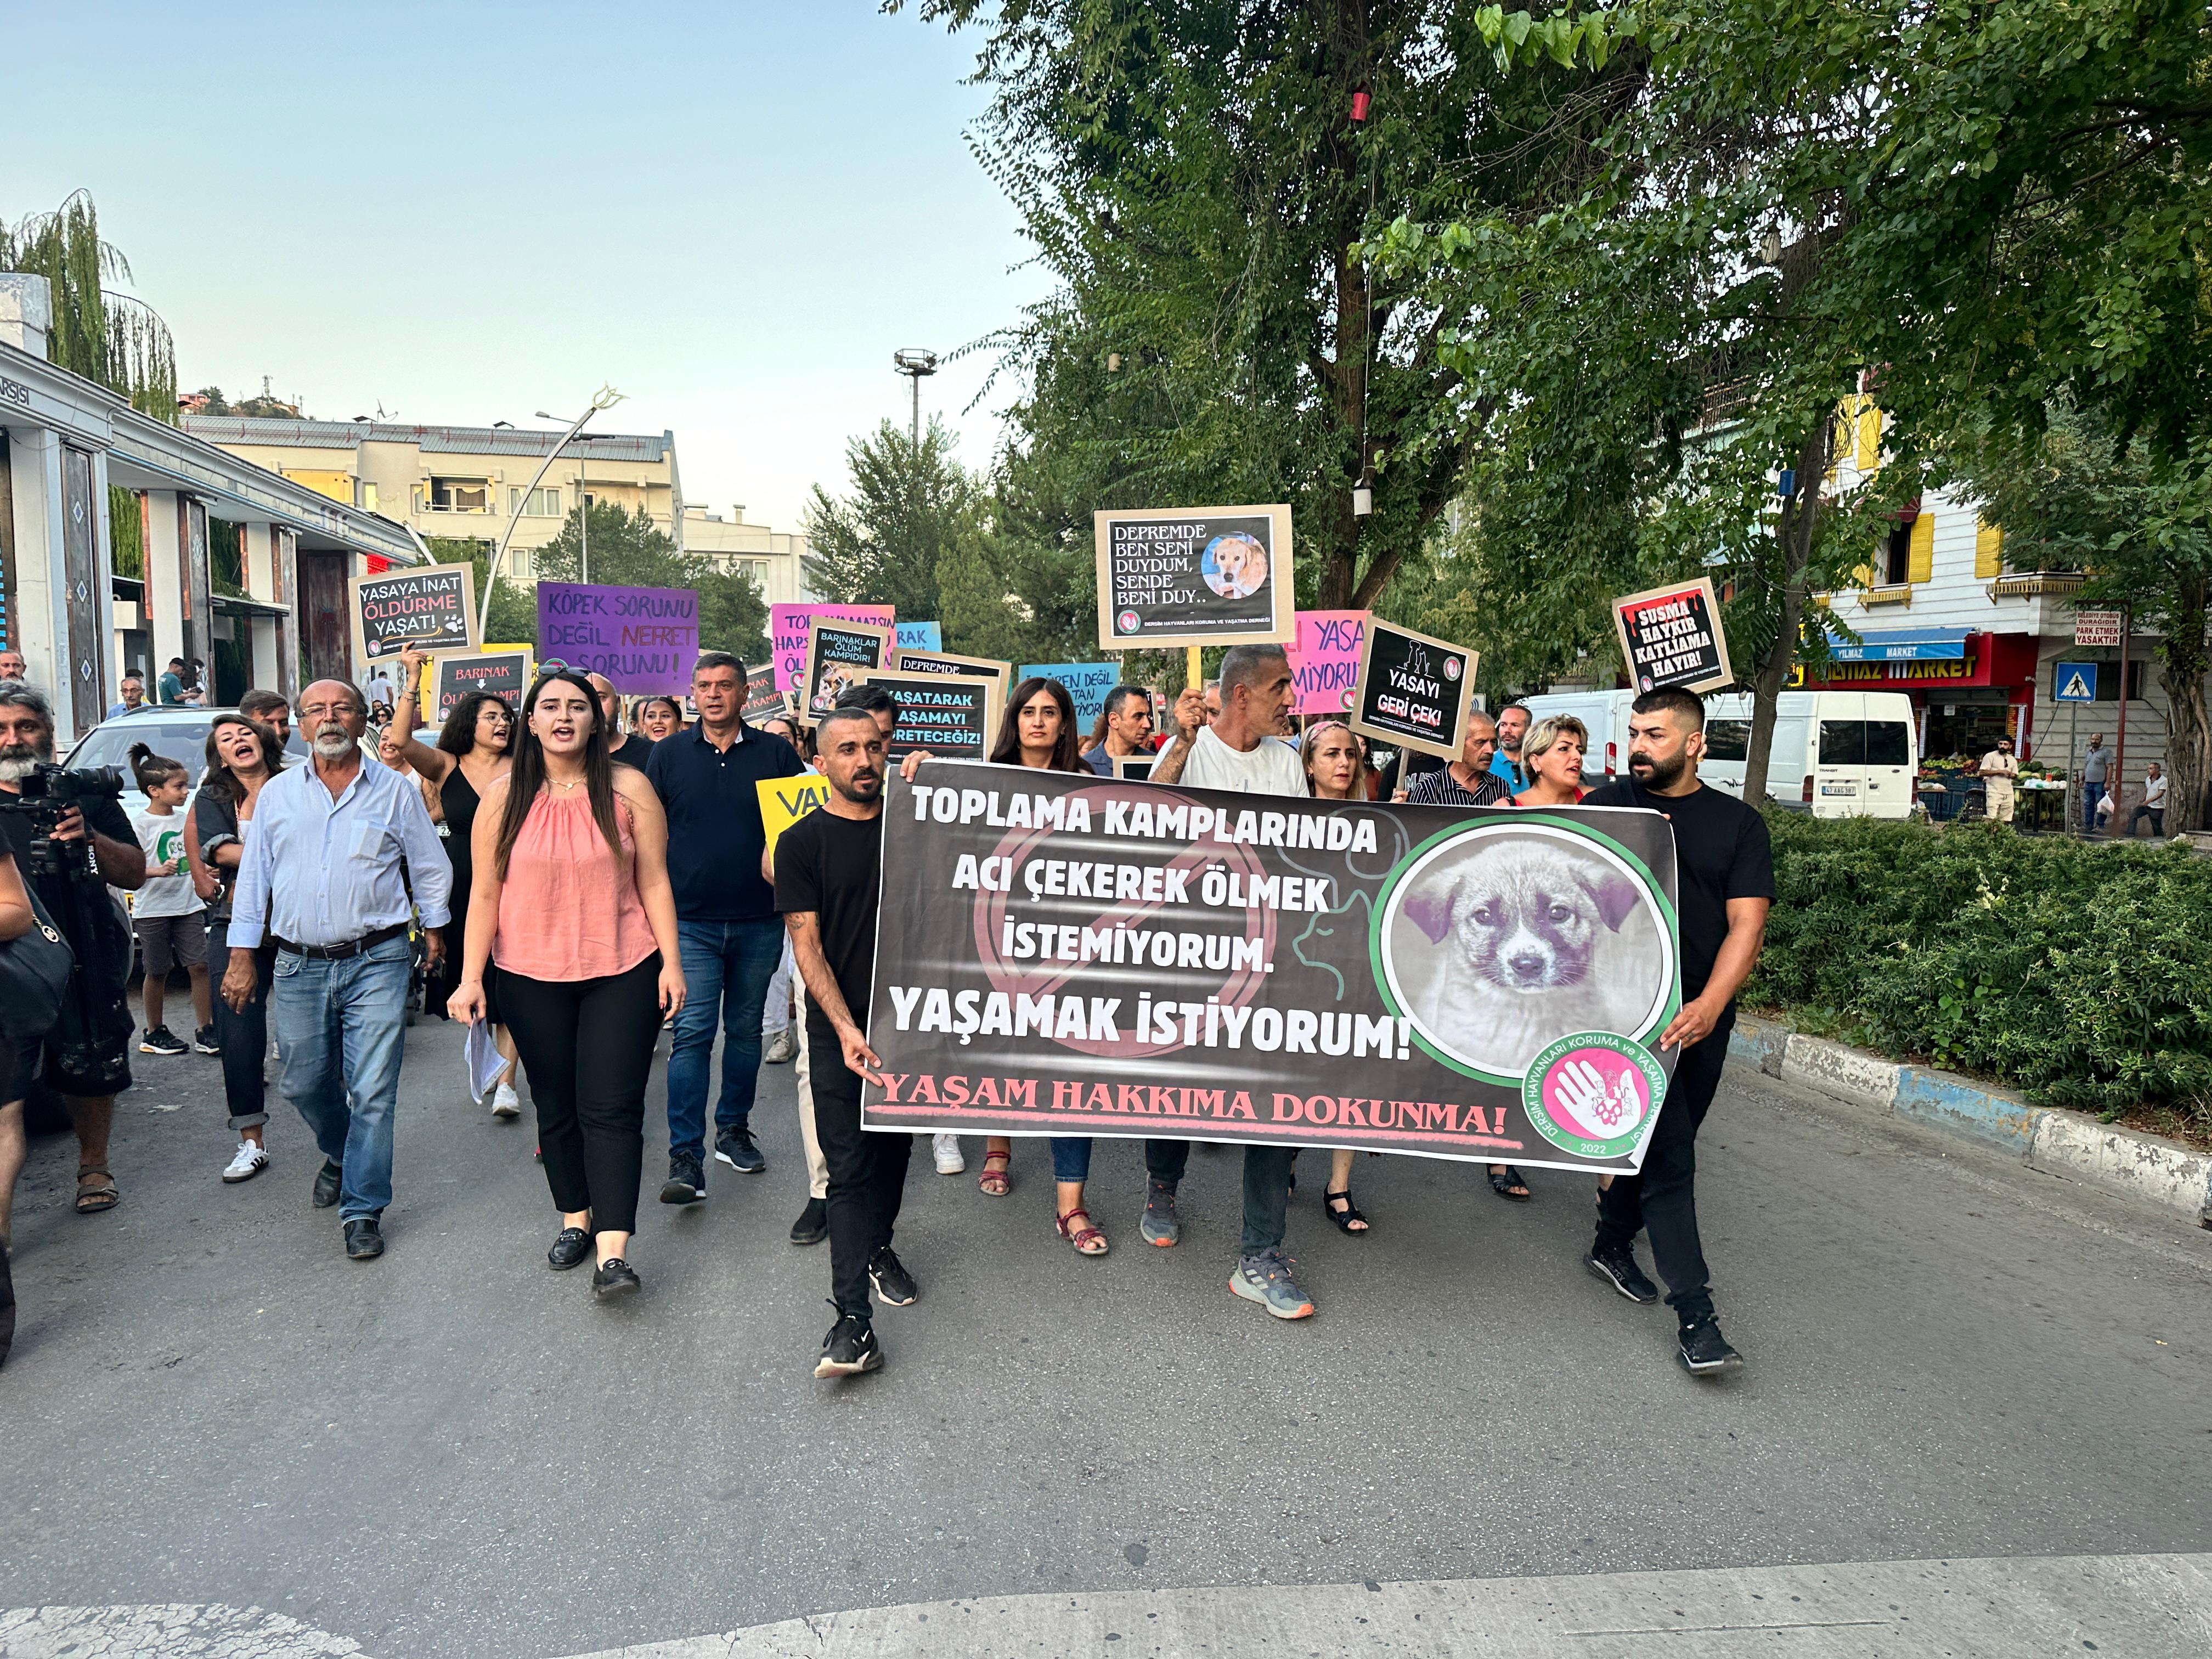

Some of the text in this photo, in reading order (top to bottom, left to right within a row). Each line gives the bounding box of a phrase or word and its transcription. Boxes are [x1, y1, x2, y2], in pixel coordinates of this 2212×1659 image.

[1114, 524, 1207, 541] DEPREMDE
[1115, 539, 1193, 557] BEN SENİ
[1116, 558, 1193, 573] DUYDUM,
[360, 577, 460, 602] YASAYA İNAT
[1116, 574, 1173, 589] SENDE
[549, 589, 693, 619] KÖPEK SORUNU
[1117, 588, 1206, 605] BENİ DUY..
[364, 594, 458, 620] ÖLDÜRME
[1638, 601, 1690, 627] SUSMA
[375, 614, 436, 636] YAŞAT!
[549, 621, 696, 646] DEĞİL NEFRET
[1640, 617, 1697, 644] HAYKIR
[821, 632, 877, 648] BARINAKLAR
[835, 641, 862, 653] ÖLÜM
[897, 630, 927, 644] RAK
[2076, 635, 2118, 644] YASAKTIR
[824, 649, 871, 663] KAMPIDIR!
[1635, 631, 1711, 664] KATLİAMA
[1838, 646, 1917, 659] YILMAZ MARKET
[456, 665, 510, 680] BARINAK
[903, 659, 960, 675] DEPREMDE
[1651, 651, 1702, 678] HAYIR!
[1827, 656, 1977, 680] ILMAZ MARKET
[1085, 669, 1113, 687] DEĞİL
[1289, 661, 1361, 693] MİYORU
[1389, 669, 1440, 699] YASAYI
[493, 690, 520, 701] MPI
[753, 692, 782, 708] KAMPI
[1071, 688, 1095, 701] TAN
[898, 710, 966, 726] AŞAMAYI
[1378, 694, 1442, 726] GERİ ÇEK!
[892, 729, 981, 744] RETECEĞİZ!
[911, 785, 1378, 854] TOPLAMA KAMPLARINDA
[88, 845, 99, 875] SONY
[952, 854, 1330, 913] ACI ÇEKEREK ÖLMEK
[1001, 915, 1274, 973] İSTEMİYORUM.
[889, 986, 1412, 1060] YAŞAMAK İSTİYORUM!
[1568, 1035, 1620, 1049] KORUMA
[1622, 1043, 1635, 1055] ve
[1528, 1042, 1568, 1098] HAYVANLARI
[1636, 1052, 1663, 1098] YAŞATMA
[877, 1073, 1507, 1135] YAŞAM HAKKIMA DOKUNMA!
[1529, 1101, 1559, 1137] DERSİM
[1580, 1143, 1607, 1154] 2022
